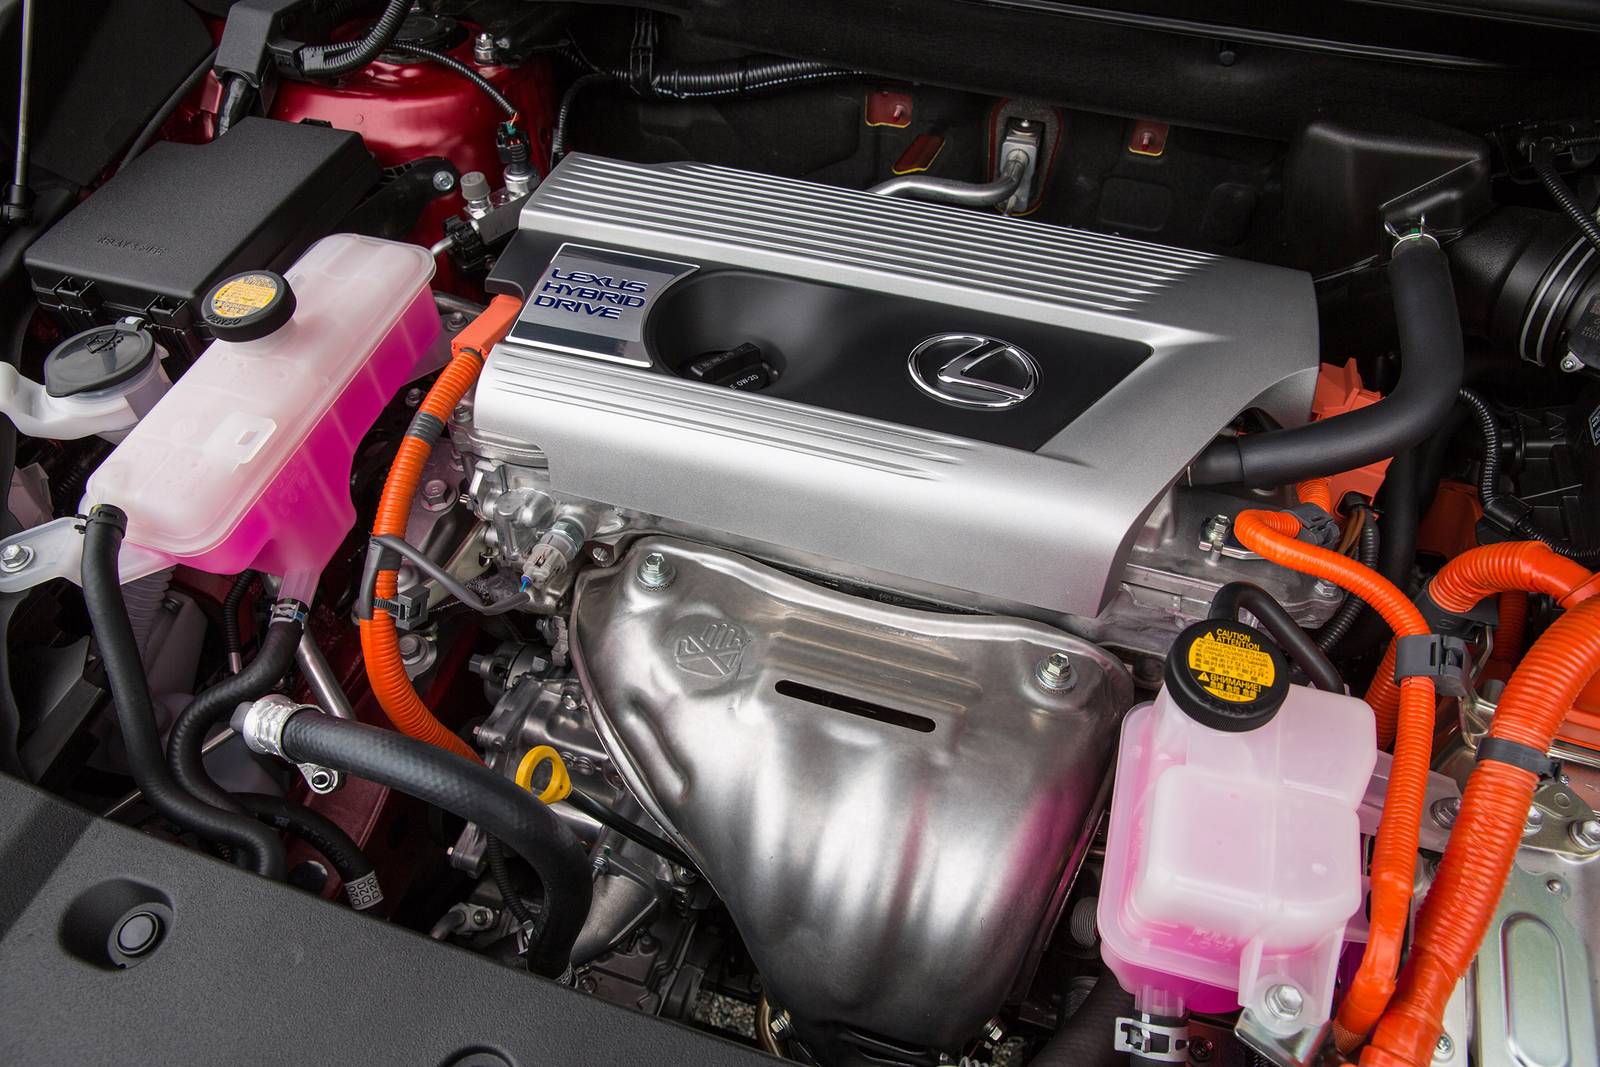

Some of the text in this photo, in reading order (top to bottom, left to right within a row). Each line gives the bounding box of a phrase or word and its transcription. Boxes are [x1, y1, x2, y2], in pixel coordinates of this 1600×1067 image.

[551, 267, 649, 293] LEXUS
[542, 280, 646, 308] HYBRID
[534, 294, 623, 320] DRIVE
[1216, 628, 1251, 643] CAUTION
[1216, 636, 1260, 651] ATTENTION
[1210, 673, 1261, 692] ВНИМАНИЕ!
[357, 881, 372, 904] D20
[367, 877, 380, 900] D20
